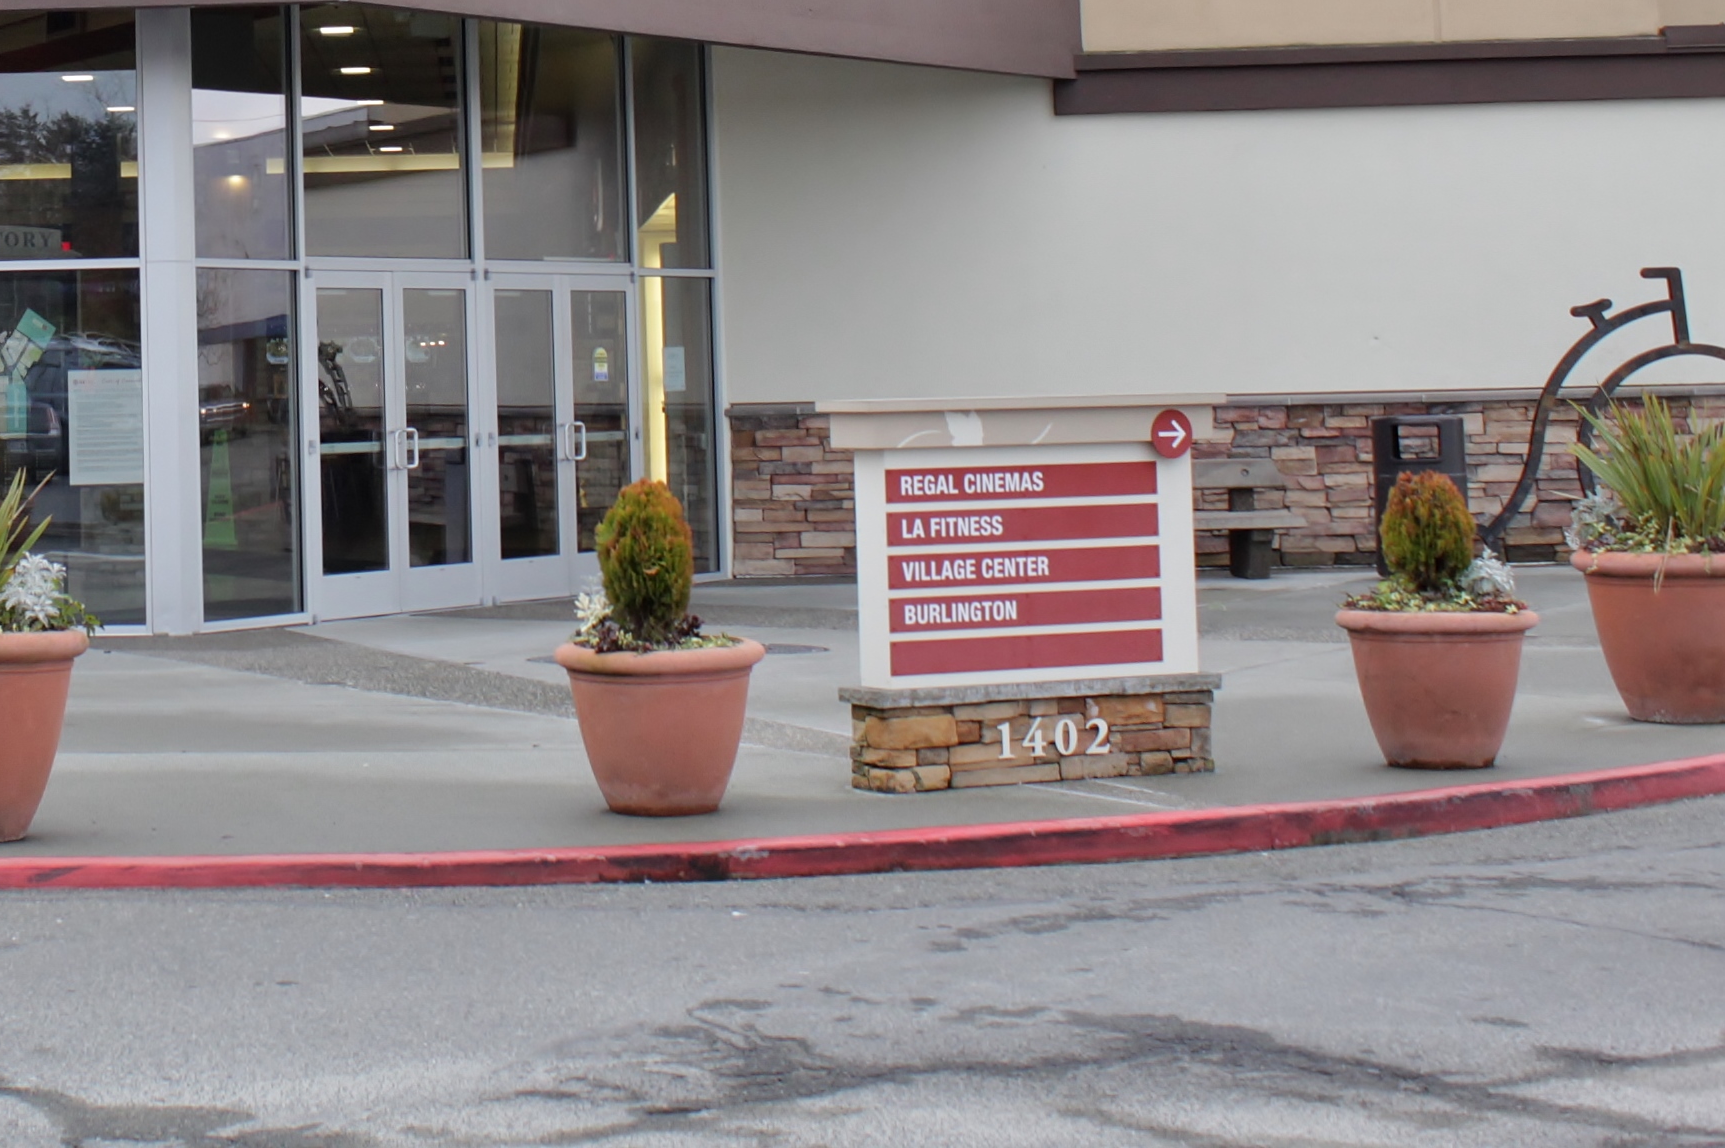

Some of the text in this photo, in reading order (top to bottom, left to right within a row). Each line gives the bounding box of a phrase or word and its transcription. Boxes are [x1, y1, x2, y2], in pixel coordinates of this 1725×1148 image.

[900, 471, 1044, 496] REGAL CINEMAS
[901, 515, 1003, 538] LA FITNESS
[902, 556, 1049, 581] VILLAGE CENTER
[904, 600, 1017, 625] BURLINGTON
[996, 716, 1111, 759] 1402
